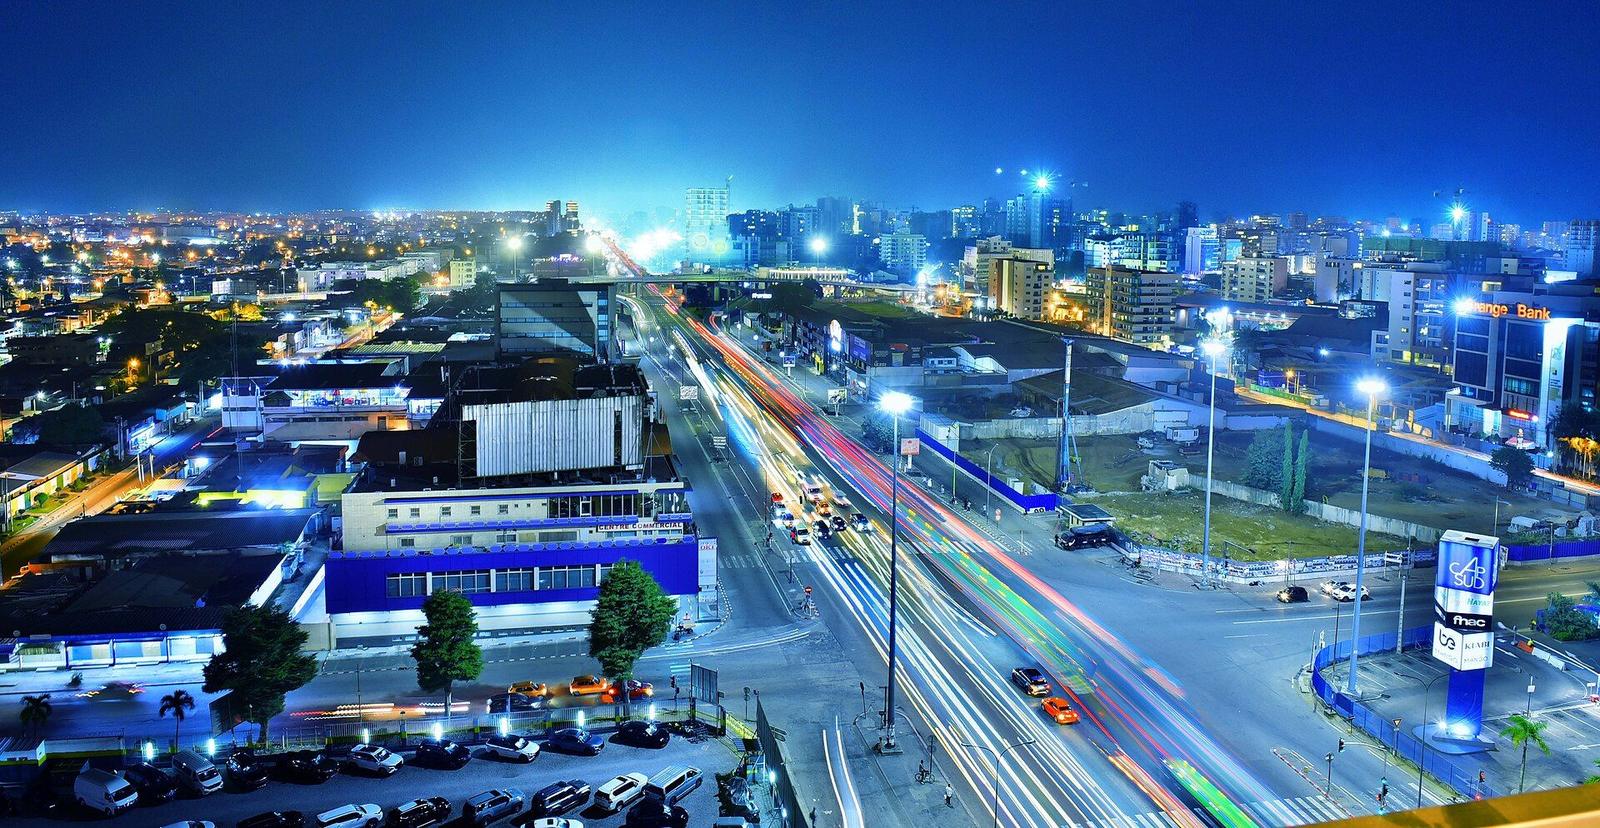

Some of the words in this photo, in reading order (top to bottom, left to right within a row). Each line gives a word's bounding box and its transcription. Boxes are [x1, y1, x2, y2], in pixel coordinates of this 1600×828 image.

[1517, 303, 1551, 320] Bank
[632, 522, 682, 530] COMMERCIAL
[1449, 557, 1486, 577] CAP
[1454, 573, 1485, 590] SUD
[1453, 615, 1486, 627] fnac
